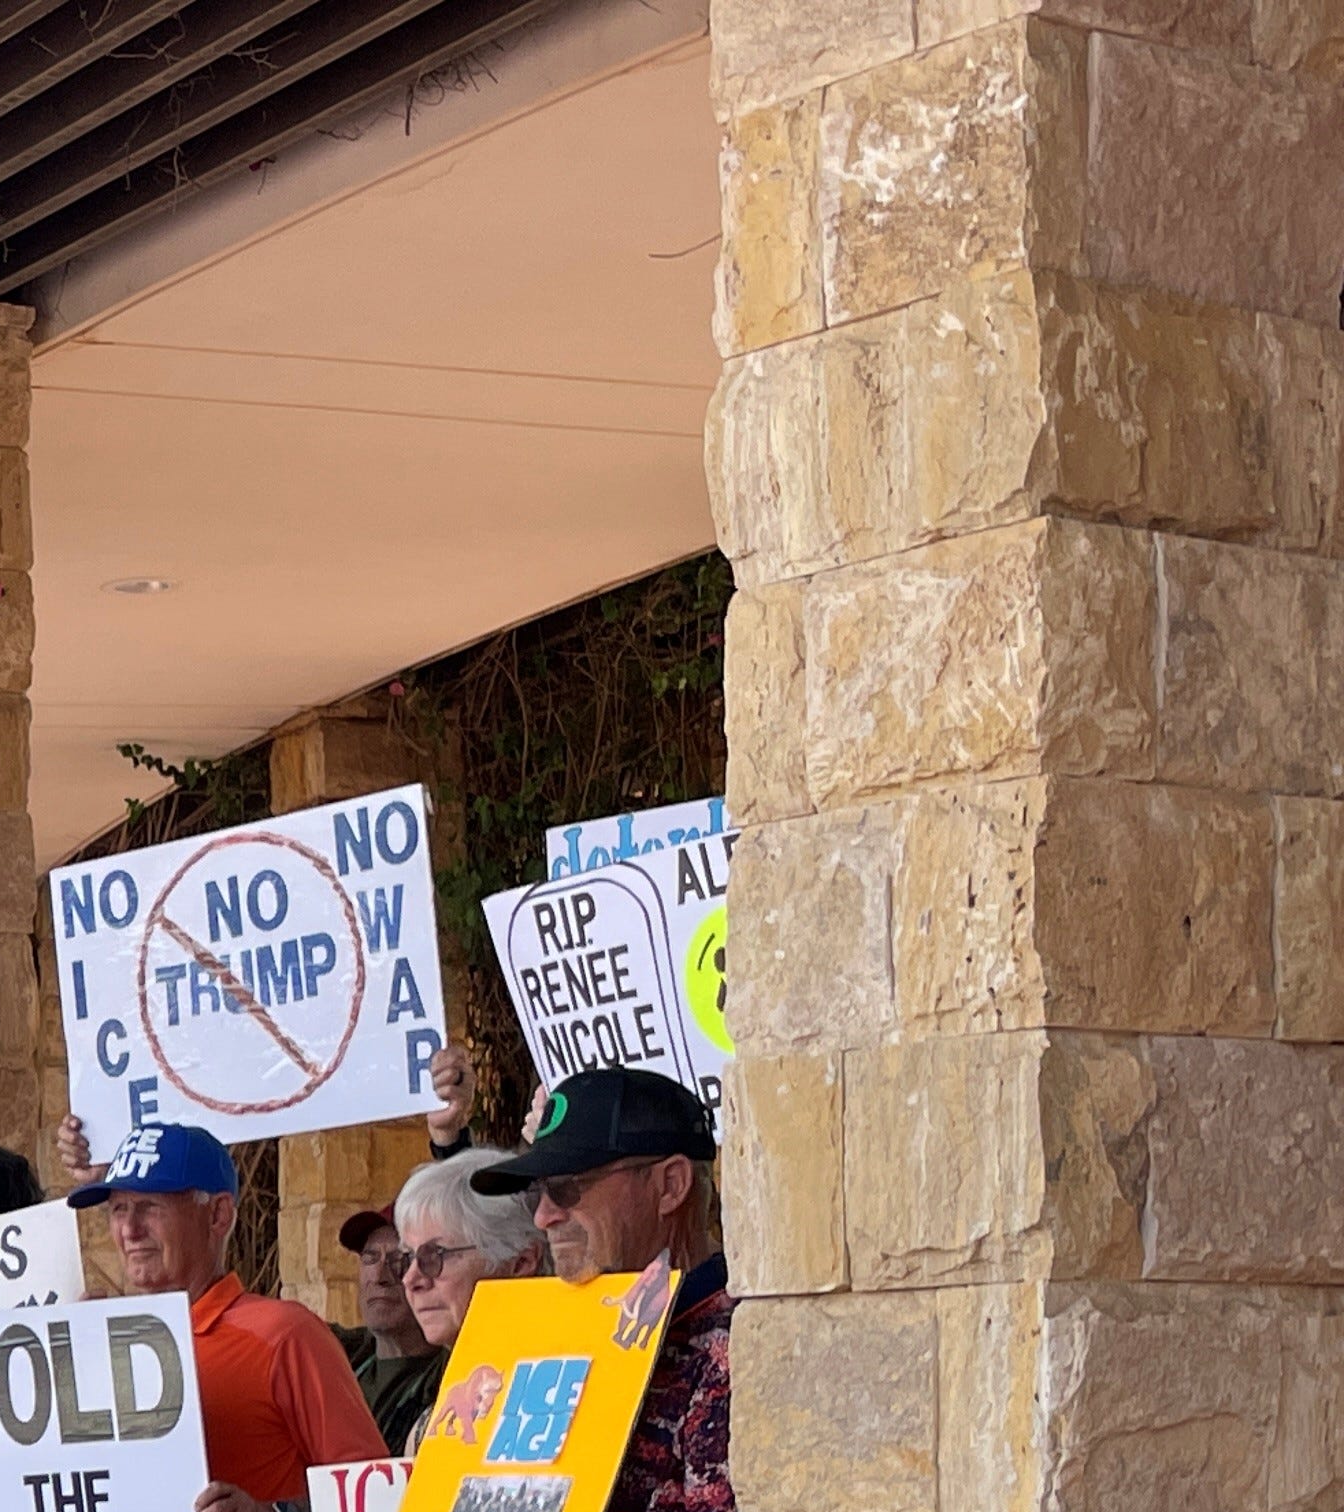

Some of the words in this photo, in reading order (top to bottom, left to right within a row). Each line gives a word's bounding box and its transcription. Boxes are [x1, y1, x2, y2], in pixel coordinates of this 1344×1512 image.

[332, 800, 419, 876] NO
[60, 869, 139, 939] NO
[204, 869, 289, 943] NO
[155, 932, 337, 1027] TRUMP
[520, 944, 638, 1021] RENEE
[539, 1004, 665, 1078] NICOLE
[505, 1359, 592, 1414] ICE
[485, 1411, 572, 1462] AGE
